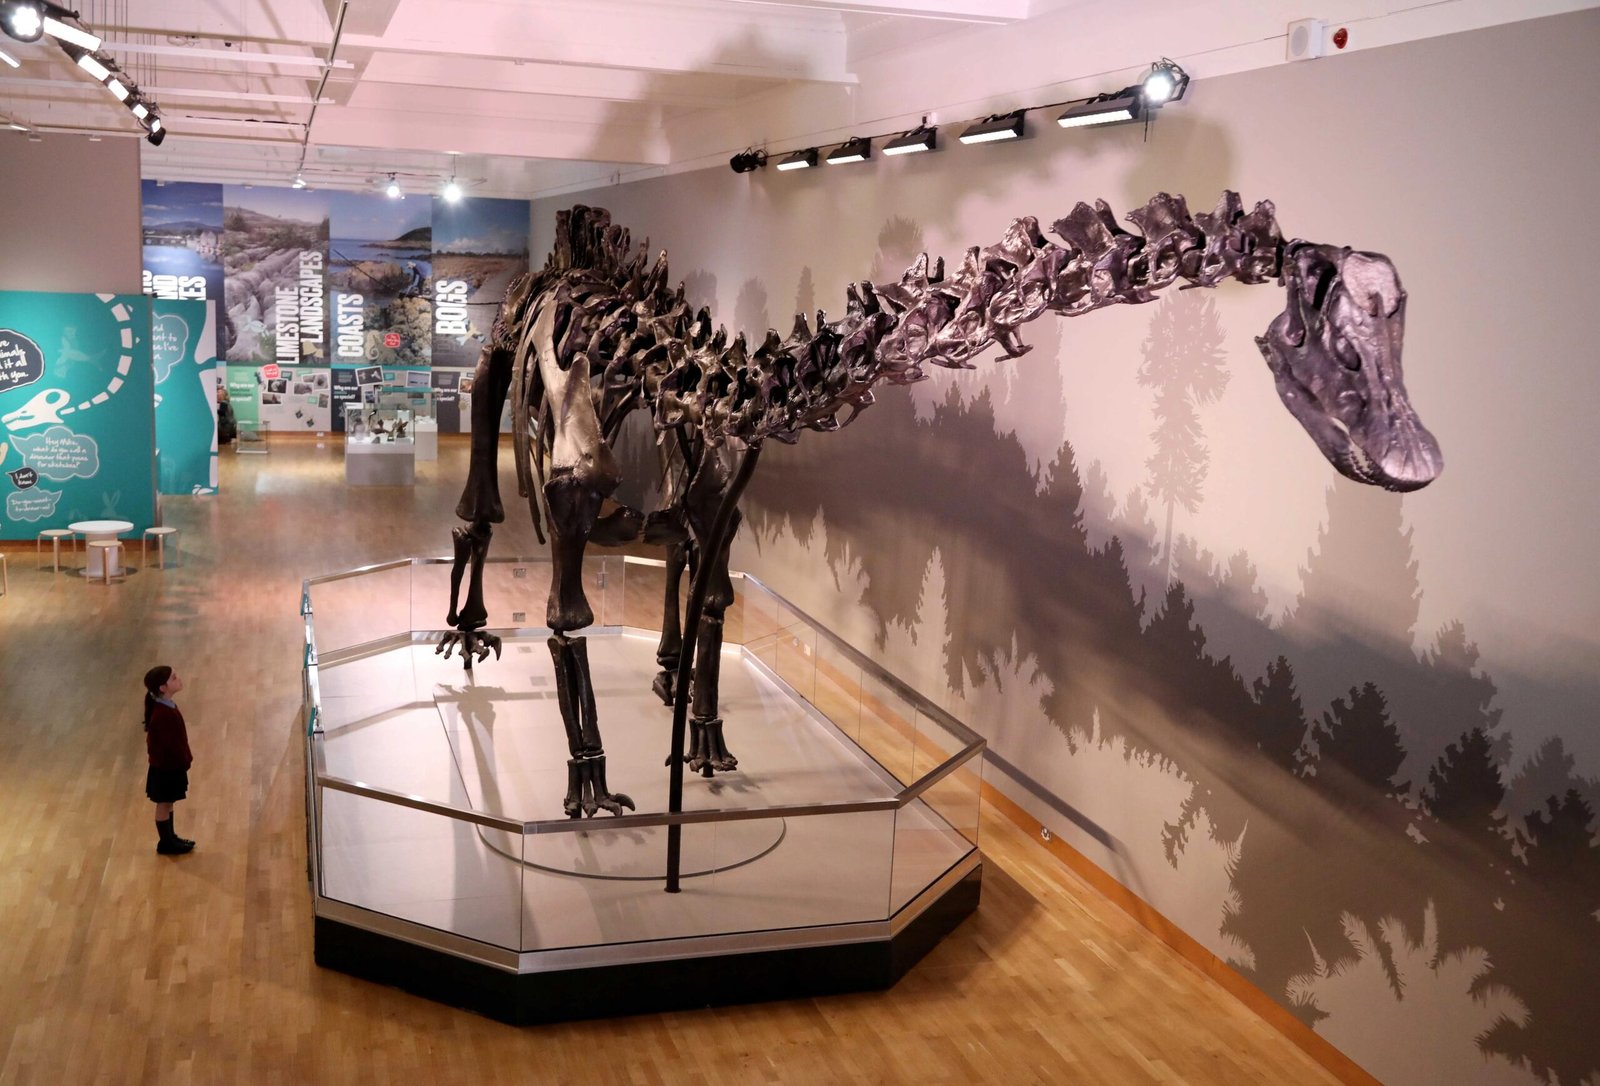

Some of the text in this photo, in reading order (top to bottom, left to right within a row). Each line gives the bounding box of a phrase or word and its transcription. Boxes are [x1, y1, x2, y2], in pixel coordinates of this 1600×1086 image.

[275, 286, 300, 364] LIMESTONE
[300, 251, 323, 343] LANDSCAPES
[337, 293, 364, 357] COASTS
[435, 280, 468, 334] BOGS
[4, 358, 14, 369] it
[15, 355, 27, 367] all
